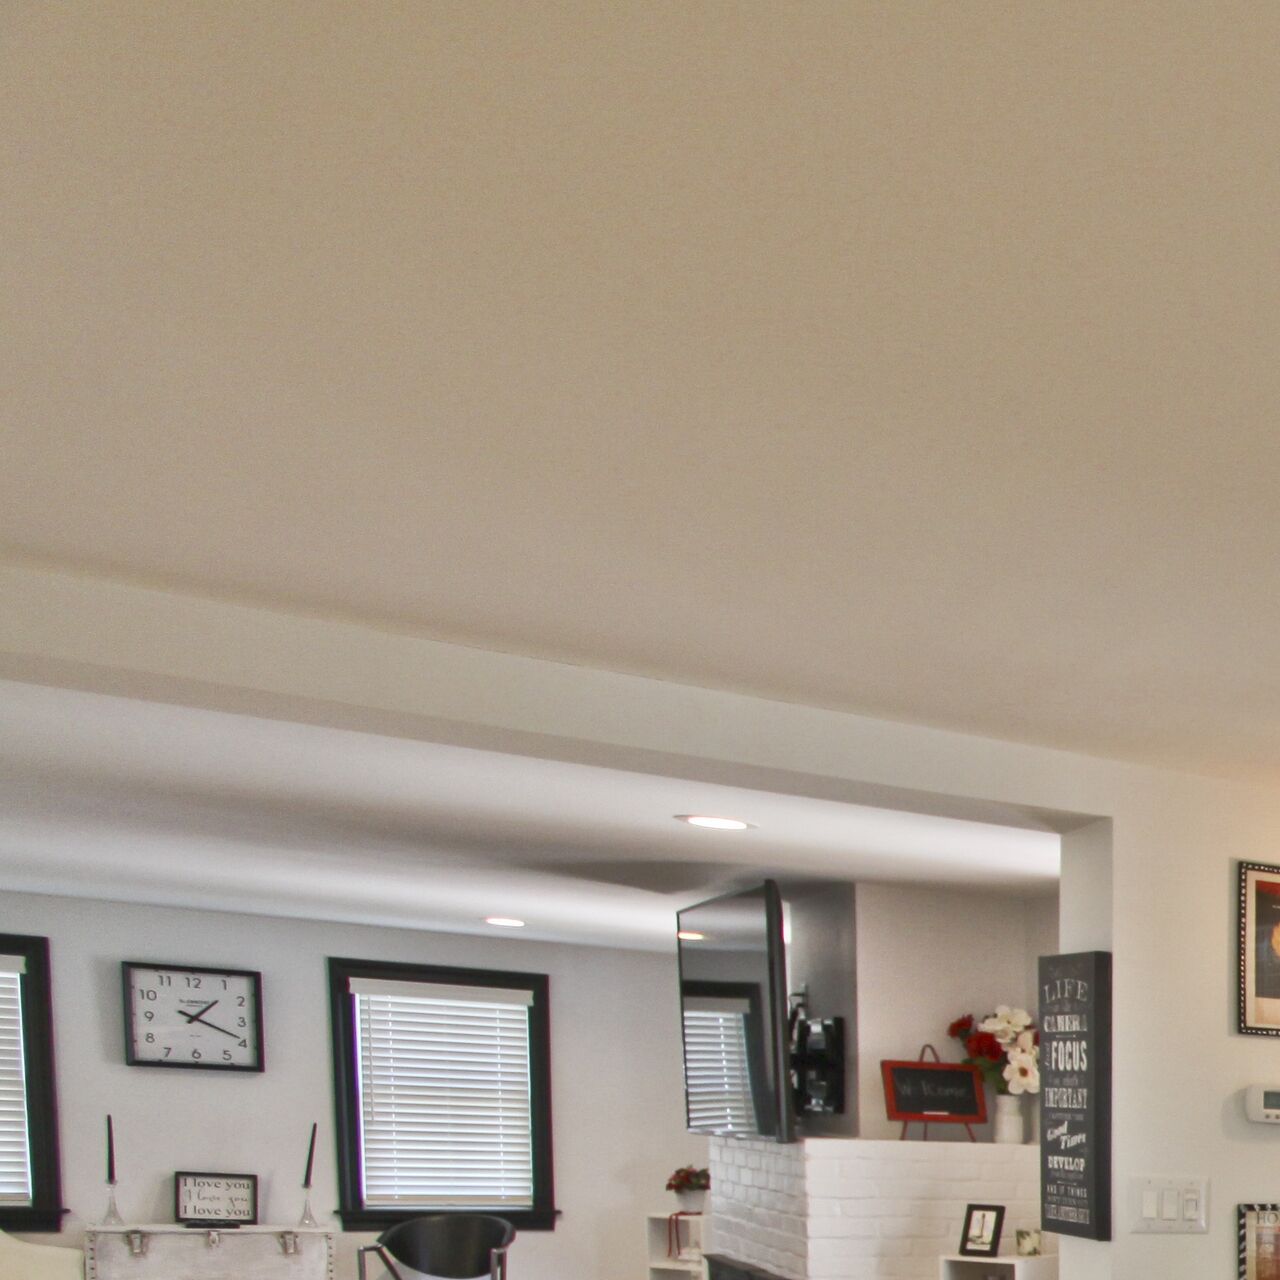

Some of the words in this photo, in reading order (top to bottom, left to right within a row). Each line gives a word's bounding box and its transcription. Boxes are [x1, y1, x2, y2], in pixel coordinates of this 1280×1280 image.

[158, 975, 172, 987] 11
[185, 977, 202, 989] 12
[221, 979, 227, 991] 1
[139, 989, 157, 1001] 10
[1044, 978, 1088, 1004] LIFE
[236, 996, 245, 1007] 2
[144, 1010, 155, 1022] 9
[237, 1017, 246, 1027] 3
[1044, 1014, 1087, 1032] CAMERA
[145, 1032, 155, 1044] 8
[238, 1039, 248, 1049] 4
[163, 1047, 172, 1058] 7
[191, 1048, 202, 1060] 6
[222, 1049, 232, 1061] 5
[1051, 1040, 1088, 1071] FOCUS
[1045, 1087, 1088, 1109] IMPORTANT
[1046, 1120, 1068, 1141] Good
[1060, 1133, 1087, 1150] Times
[1048, 1155, 1085, 1172] DEVELOP
[193, 1178, 222, 1188] love
[225, 1182, 250, 1191] you
[193, 1205, 222, 1215] love
[225, 1209, 250, 1218] you
